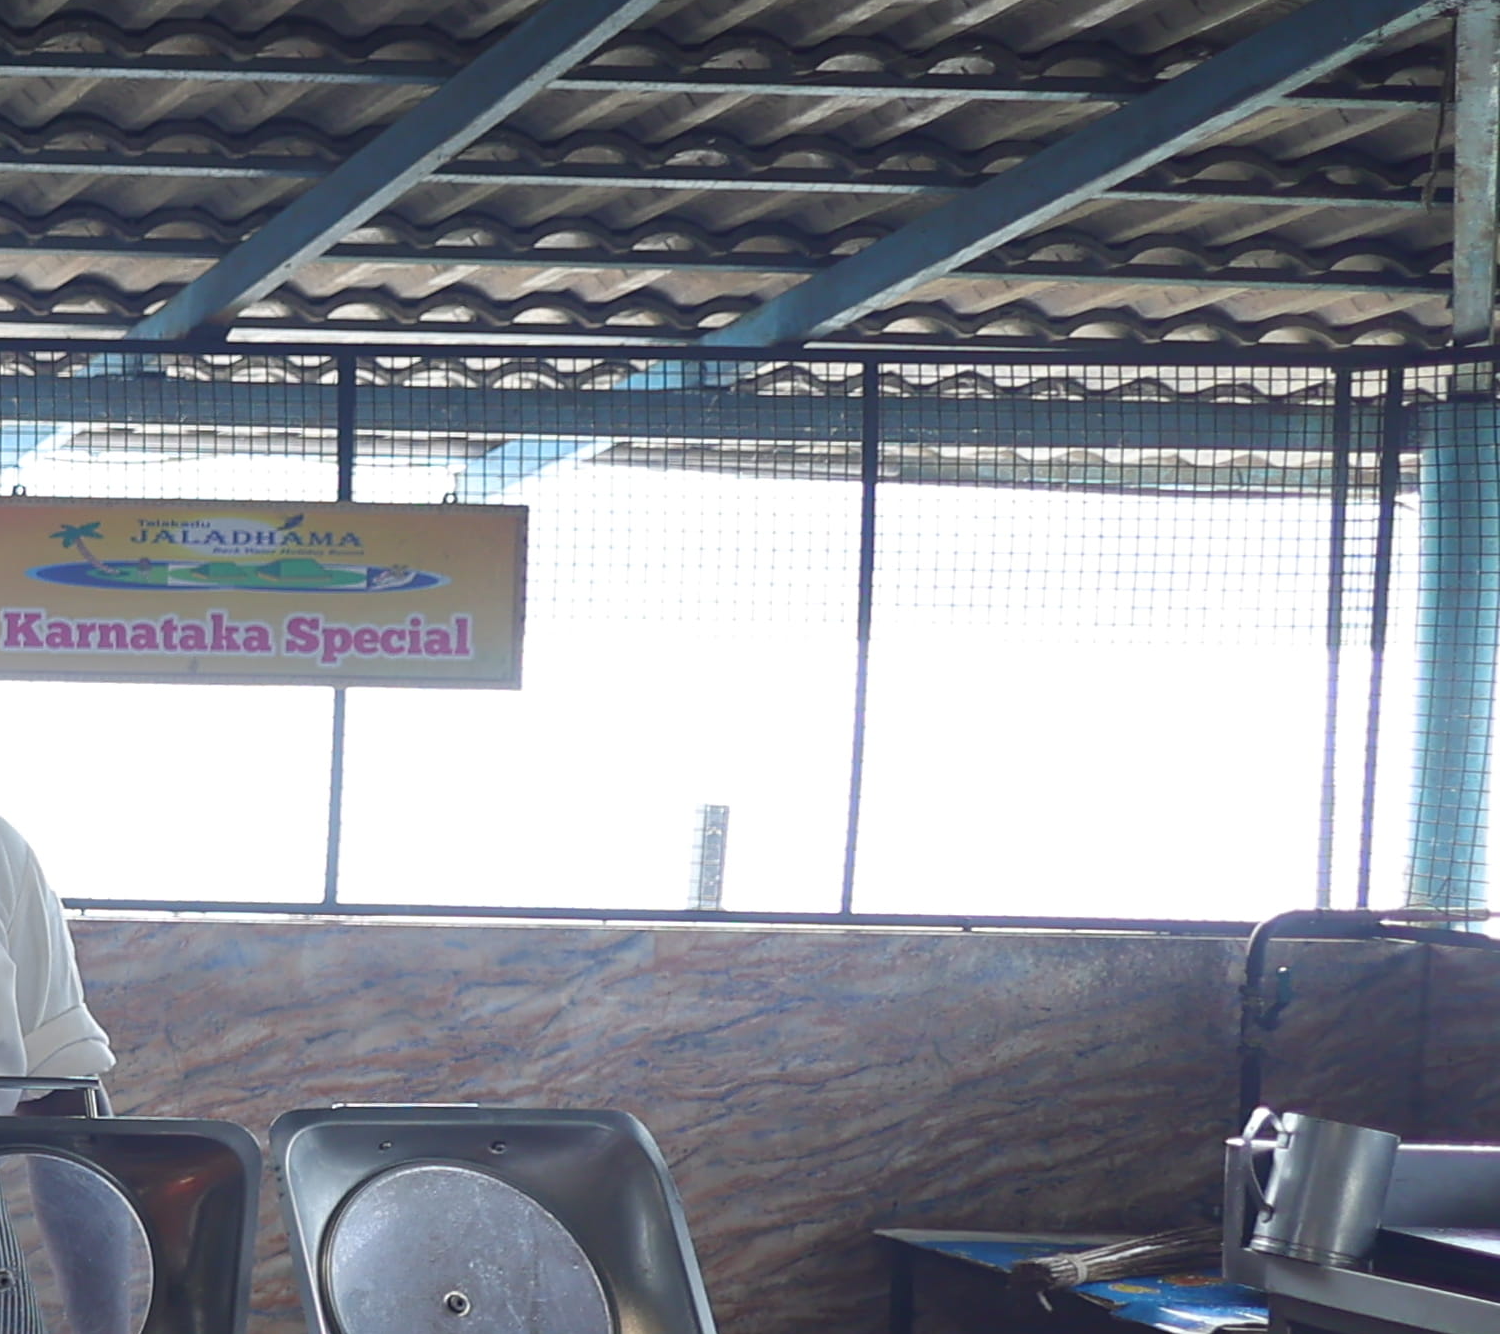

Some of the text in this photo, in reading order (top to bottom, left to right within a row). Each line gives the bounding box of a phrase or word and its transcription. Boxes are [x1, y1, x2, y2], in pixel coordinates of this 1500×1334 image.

[129, 529, 364, 548] JALADHAMA
[2, 611, 471, 664] Karnataka Special
